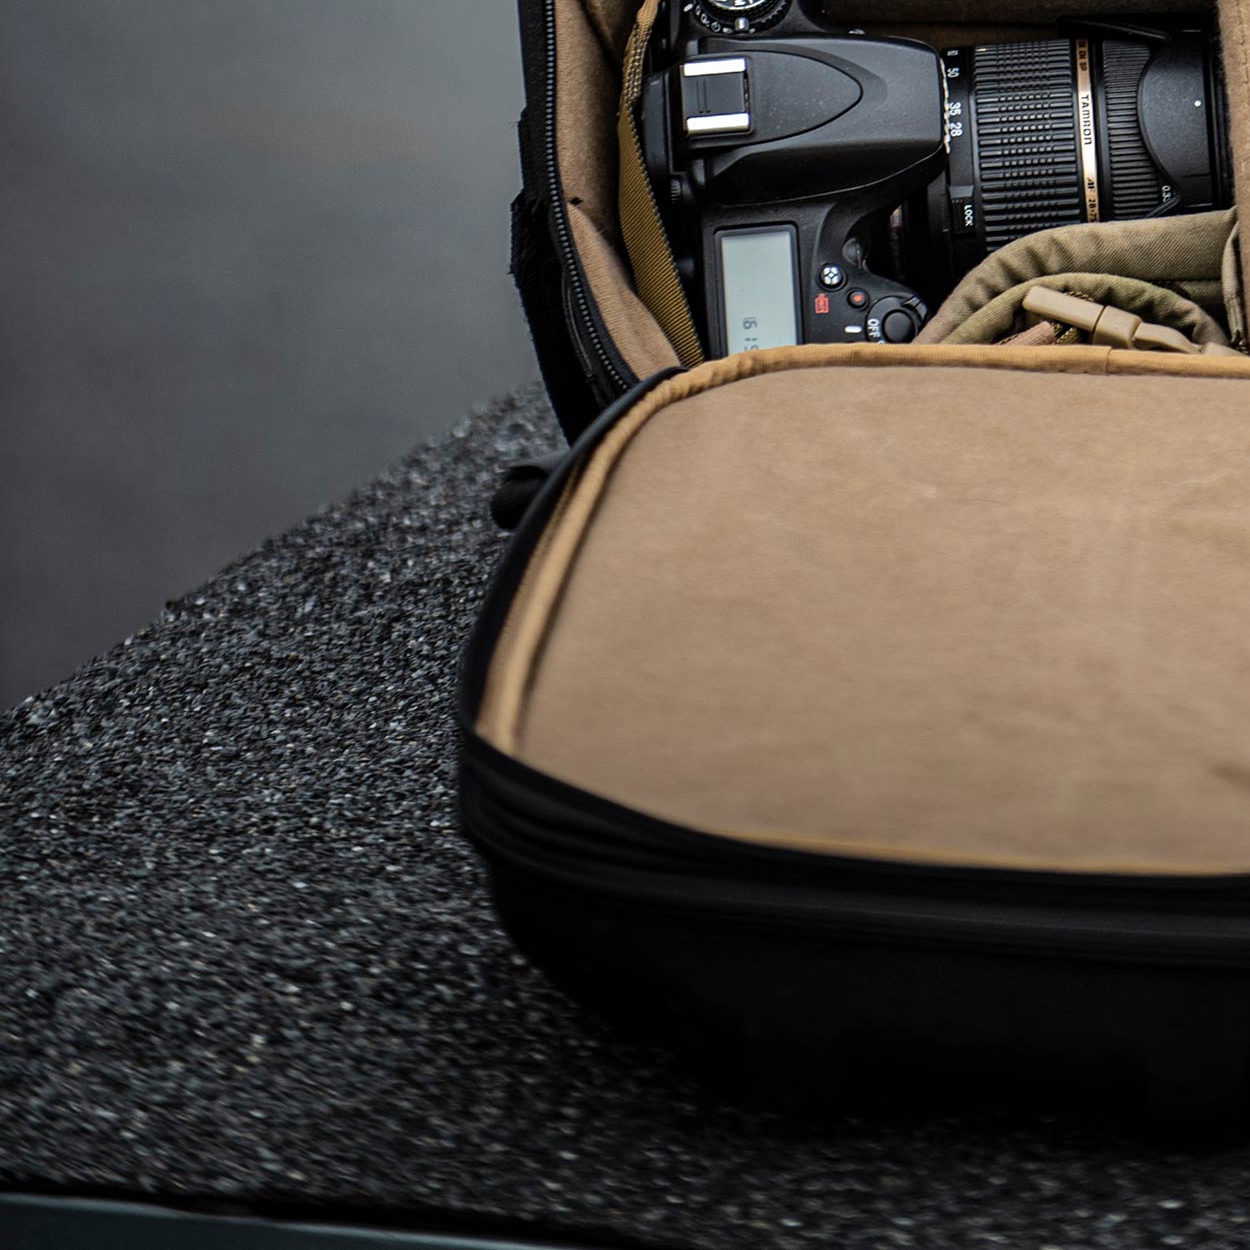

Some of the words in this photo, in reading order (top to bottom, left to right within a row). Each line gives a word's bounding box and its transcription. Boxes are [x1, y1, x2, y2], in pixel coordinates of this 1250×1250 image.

[947, 67, 960, 78] 50
[949, 102, 961, 116] 35
[1081, 94, 1093, 145] TAMRON
[950, 122, 963, 137] 28
[964, 204, 973, 227] LOCK
[867, 318, 881, 338] OFF
